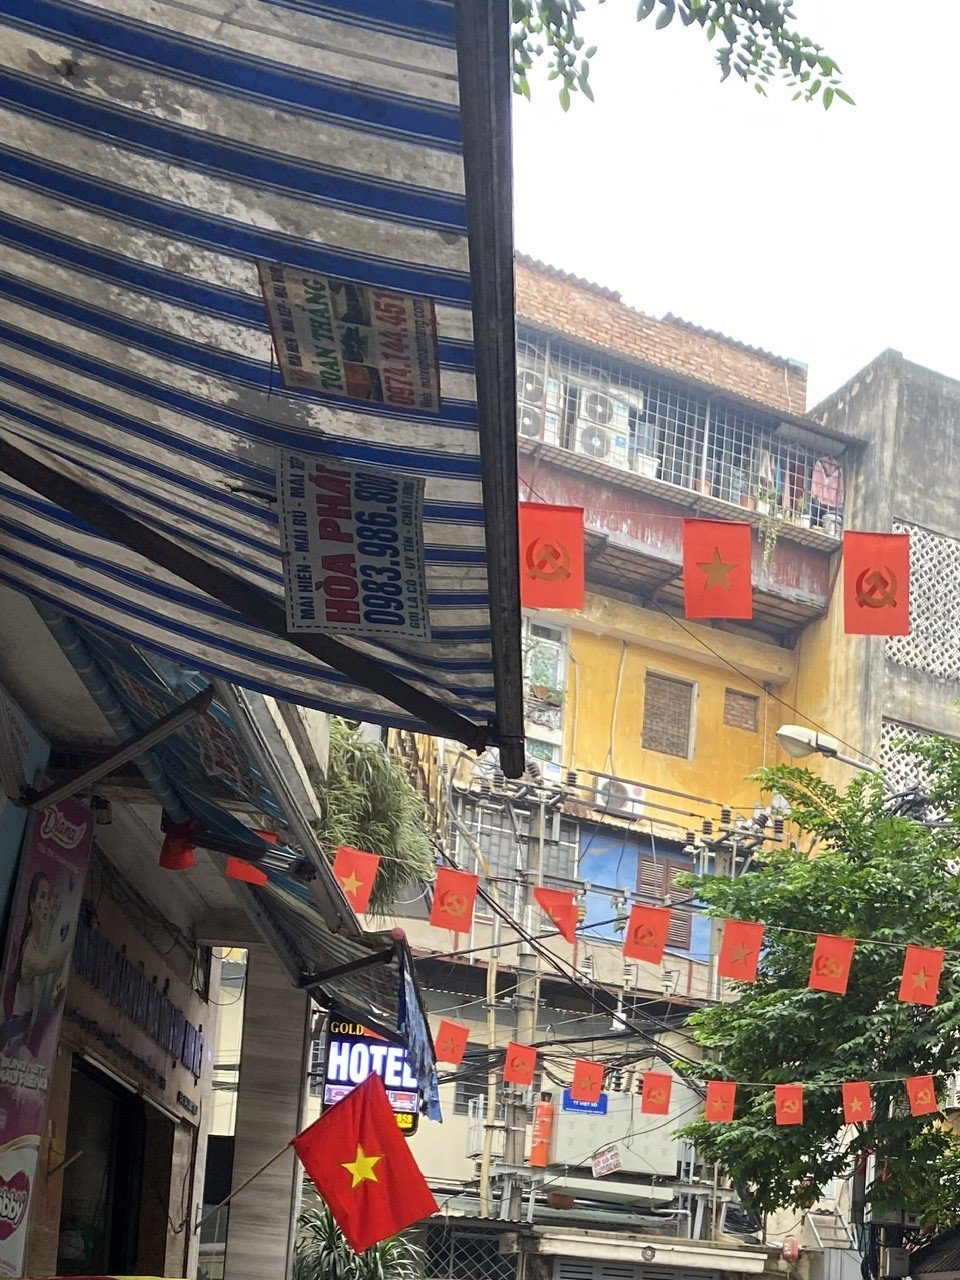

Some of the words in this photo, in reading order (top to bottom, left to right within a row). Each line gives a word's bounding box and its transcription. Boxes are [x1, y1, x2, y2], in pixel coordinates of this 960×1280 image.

[373, 291, 415, 406] 0974.144.451
[287, 474, 305, 498] MÁI
[308, 463, 354, 544] PHÁT
[290, 530, 310, 553] MÁI
[353, 472, 406, 626] 0983.986.800
[402, 536, 415, 552] TÍN
[404, 555, 416, 569] UY
[294, 564, 313, 592] HIÊN
[315, 553, 361, 624] HÒA
[296, 597, 315, 620] MÁI
[327, 1041, 418, 1088] HOTEL
